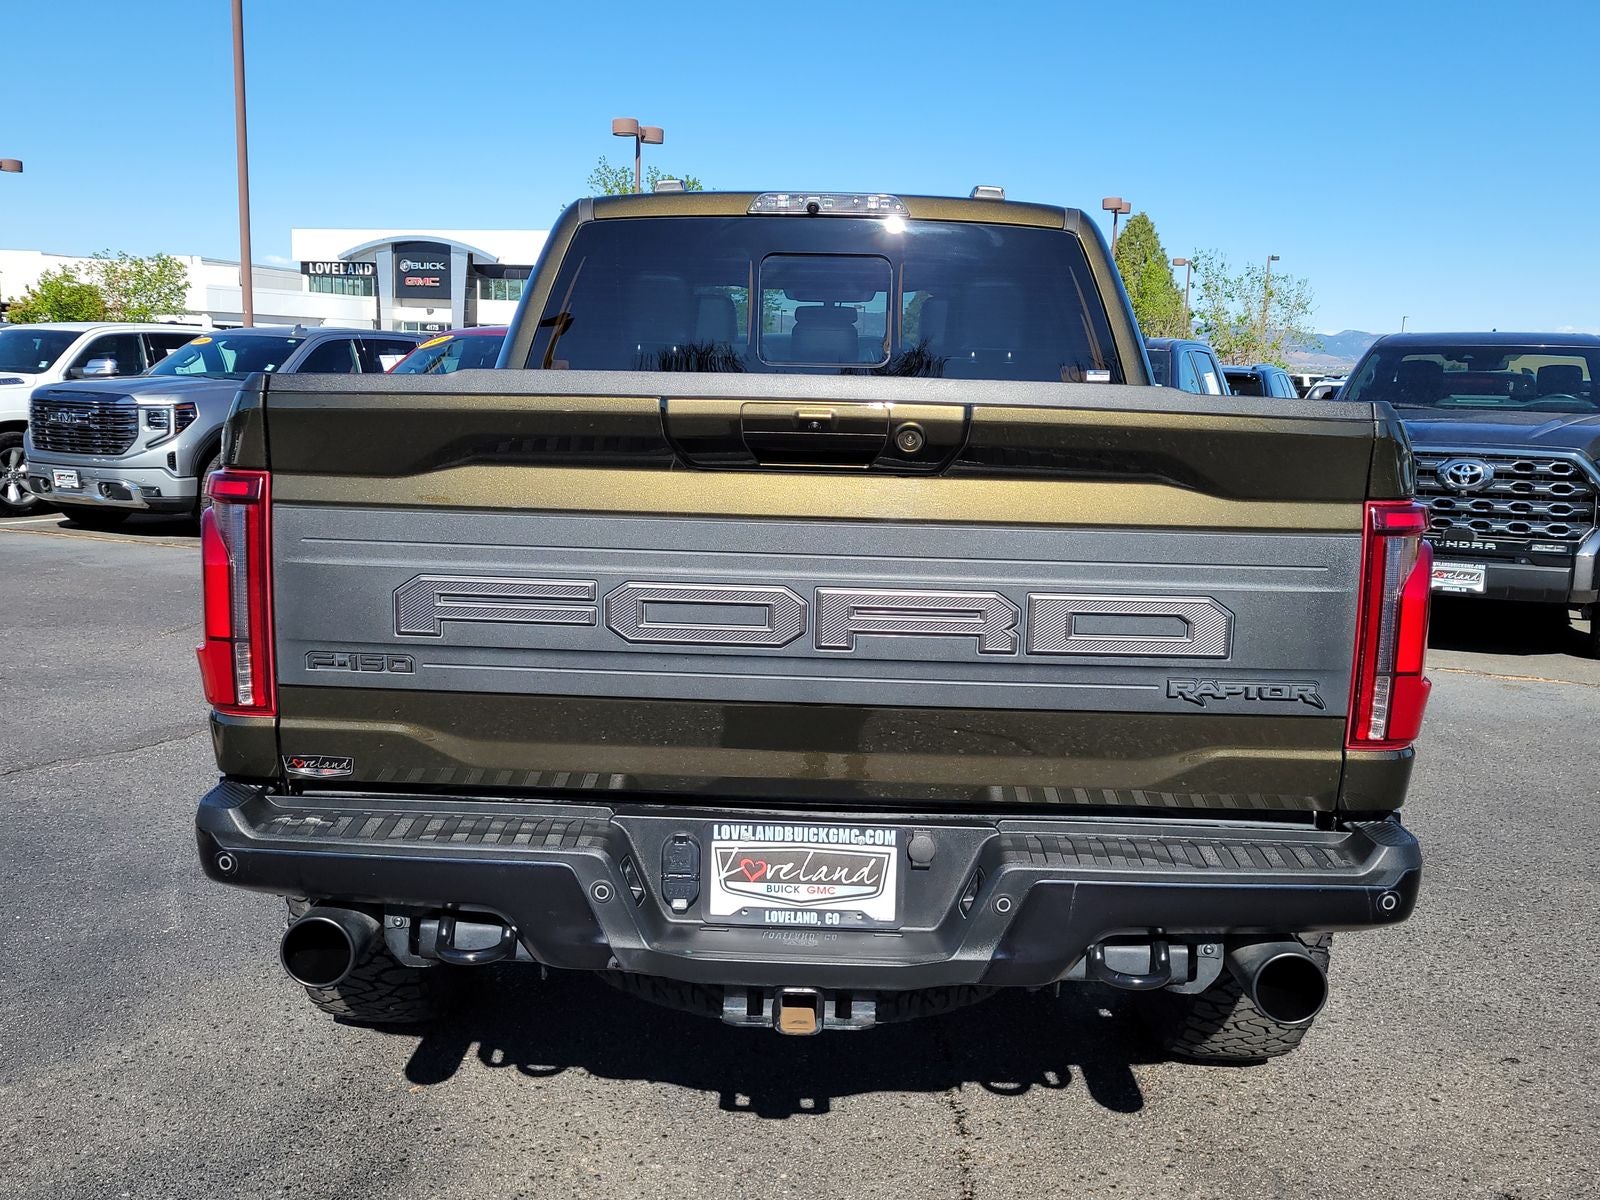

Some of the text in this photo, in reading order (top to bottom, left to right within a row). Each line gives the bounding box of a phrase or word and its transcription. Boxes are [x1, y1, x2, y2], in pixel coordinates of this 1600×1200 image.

[309, 261, 373, 275] LOVELAND
[410, 261, 445, 270] BUICK
[405, 276, 440, 286] GMC
[1430, 540, 1496, 550] UNDRA
[394, 574, 1234, 659] FORD
[305, 651, 415, 674] F-150
[1166, 677, 1326, 710] RAPTOR
[713, 824, 896, 846] LOVELANDBUICKGMC.COM
[718, 847, 879, 884] Loveland
[766, 884, 836, 895] BUICK GMC
[765, 910, 840, 926] LOVELAND, CO
